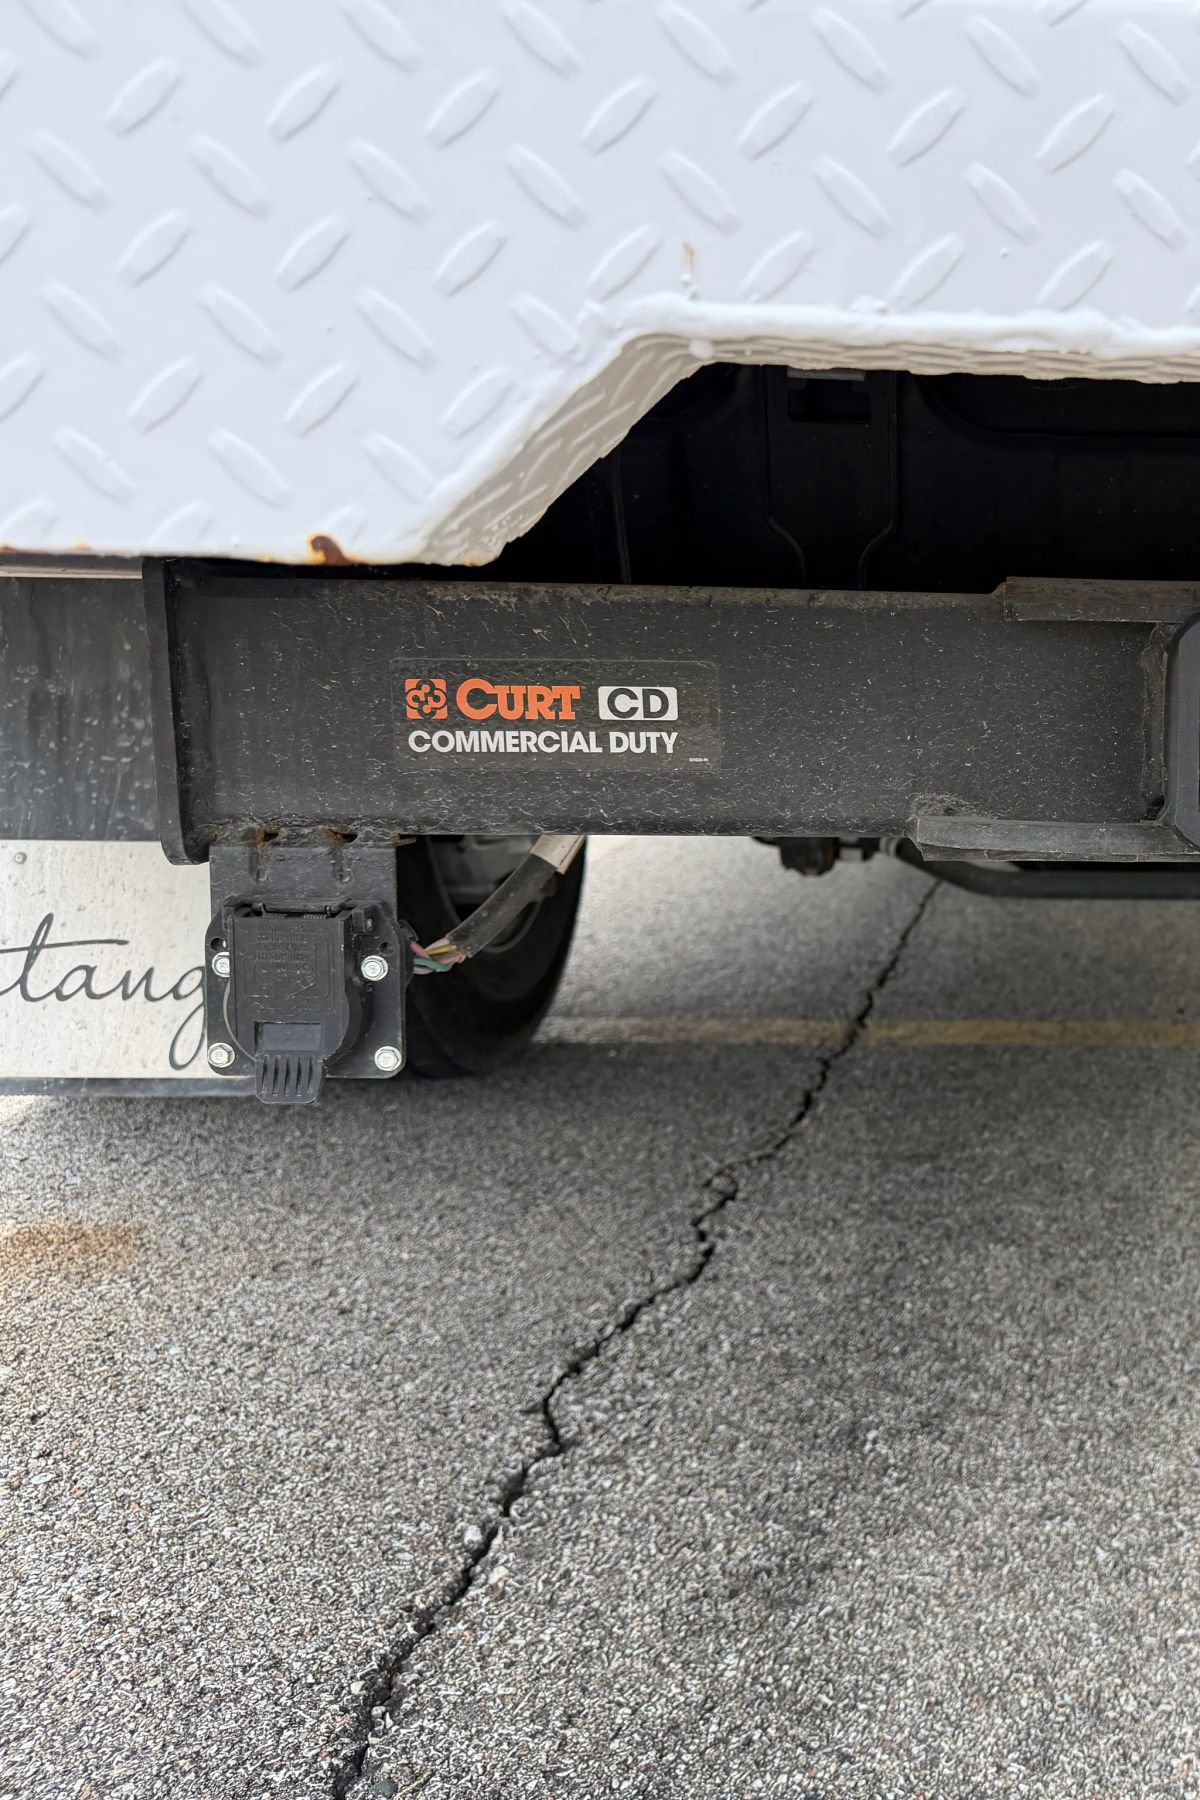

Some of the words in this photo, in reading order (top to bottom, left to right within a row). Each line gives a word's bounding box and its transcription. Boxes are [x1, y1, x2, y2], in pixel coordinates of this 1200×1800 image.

[456, 678, 581, 719] CURT
[607, 687, 669, 718] CD
[408, 730, 602, 753] COMMERCIAL
[610, 731, 678, 753] DUTY
[0, 912, 206, 1070] tang
